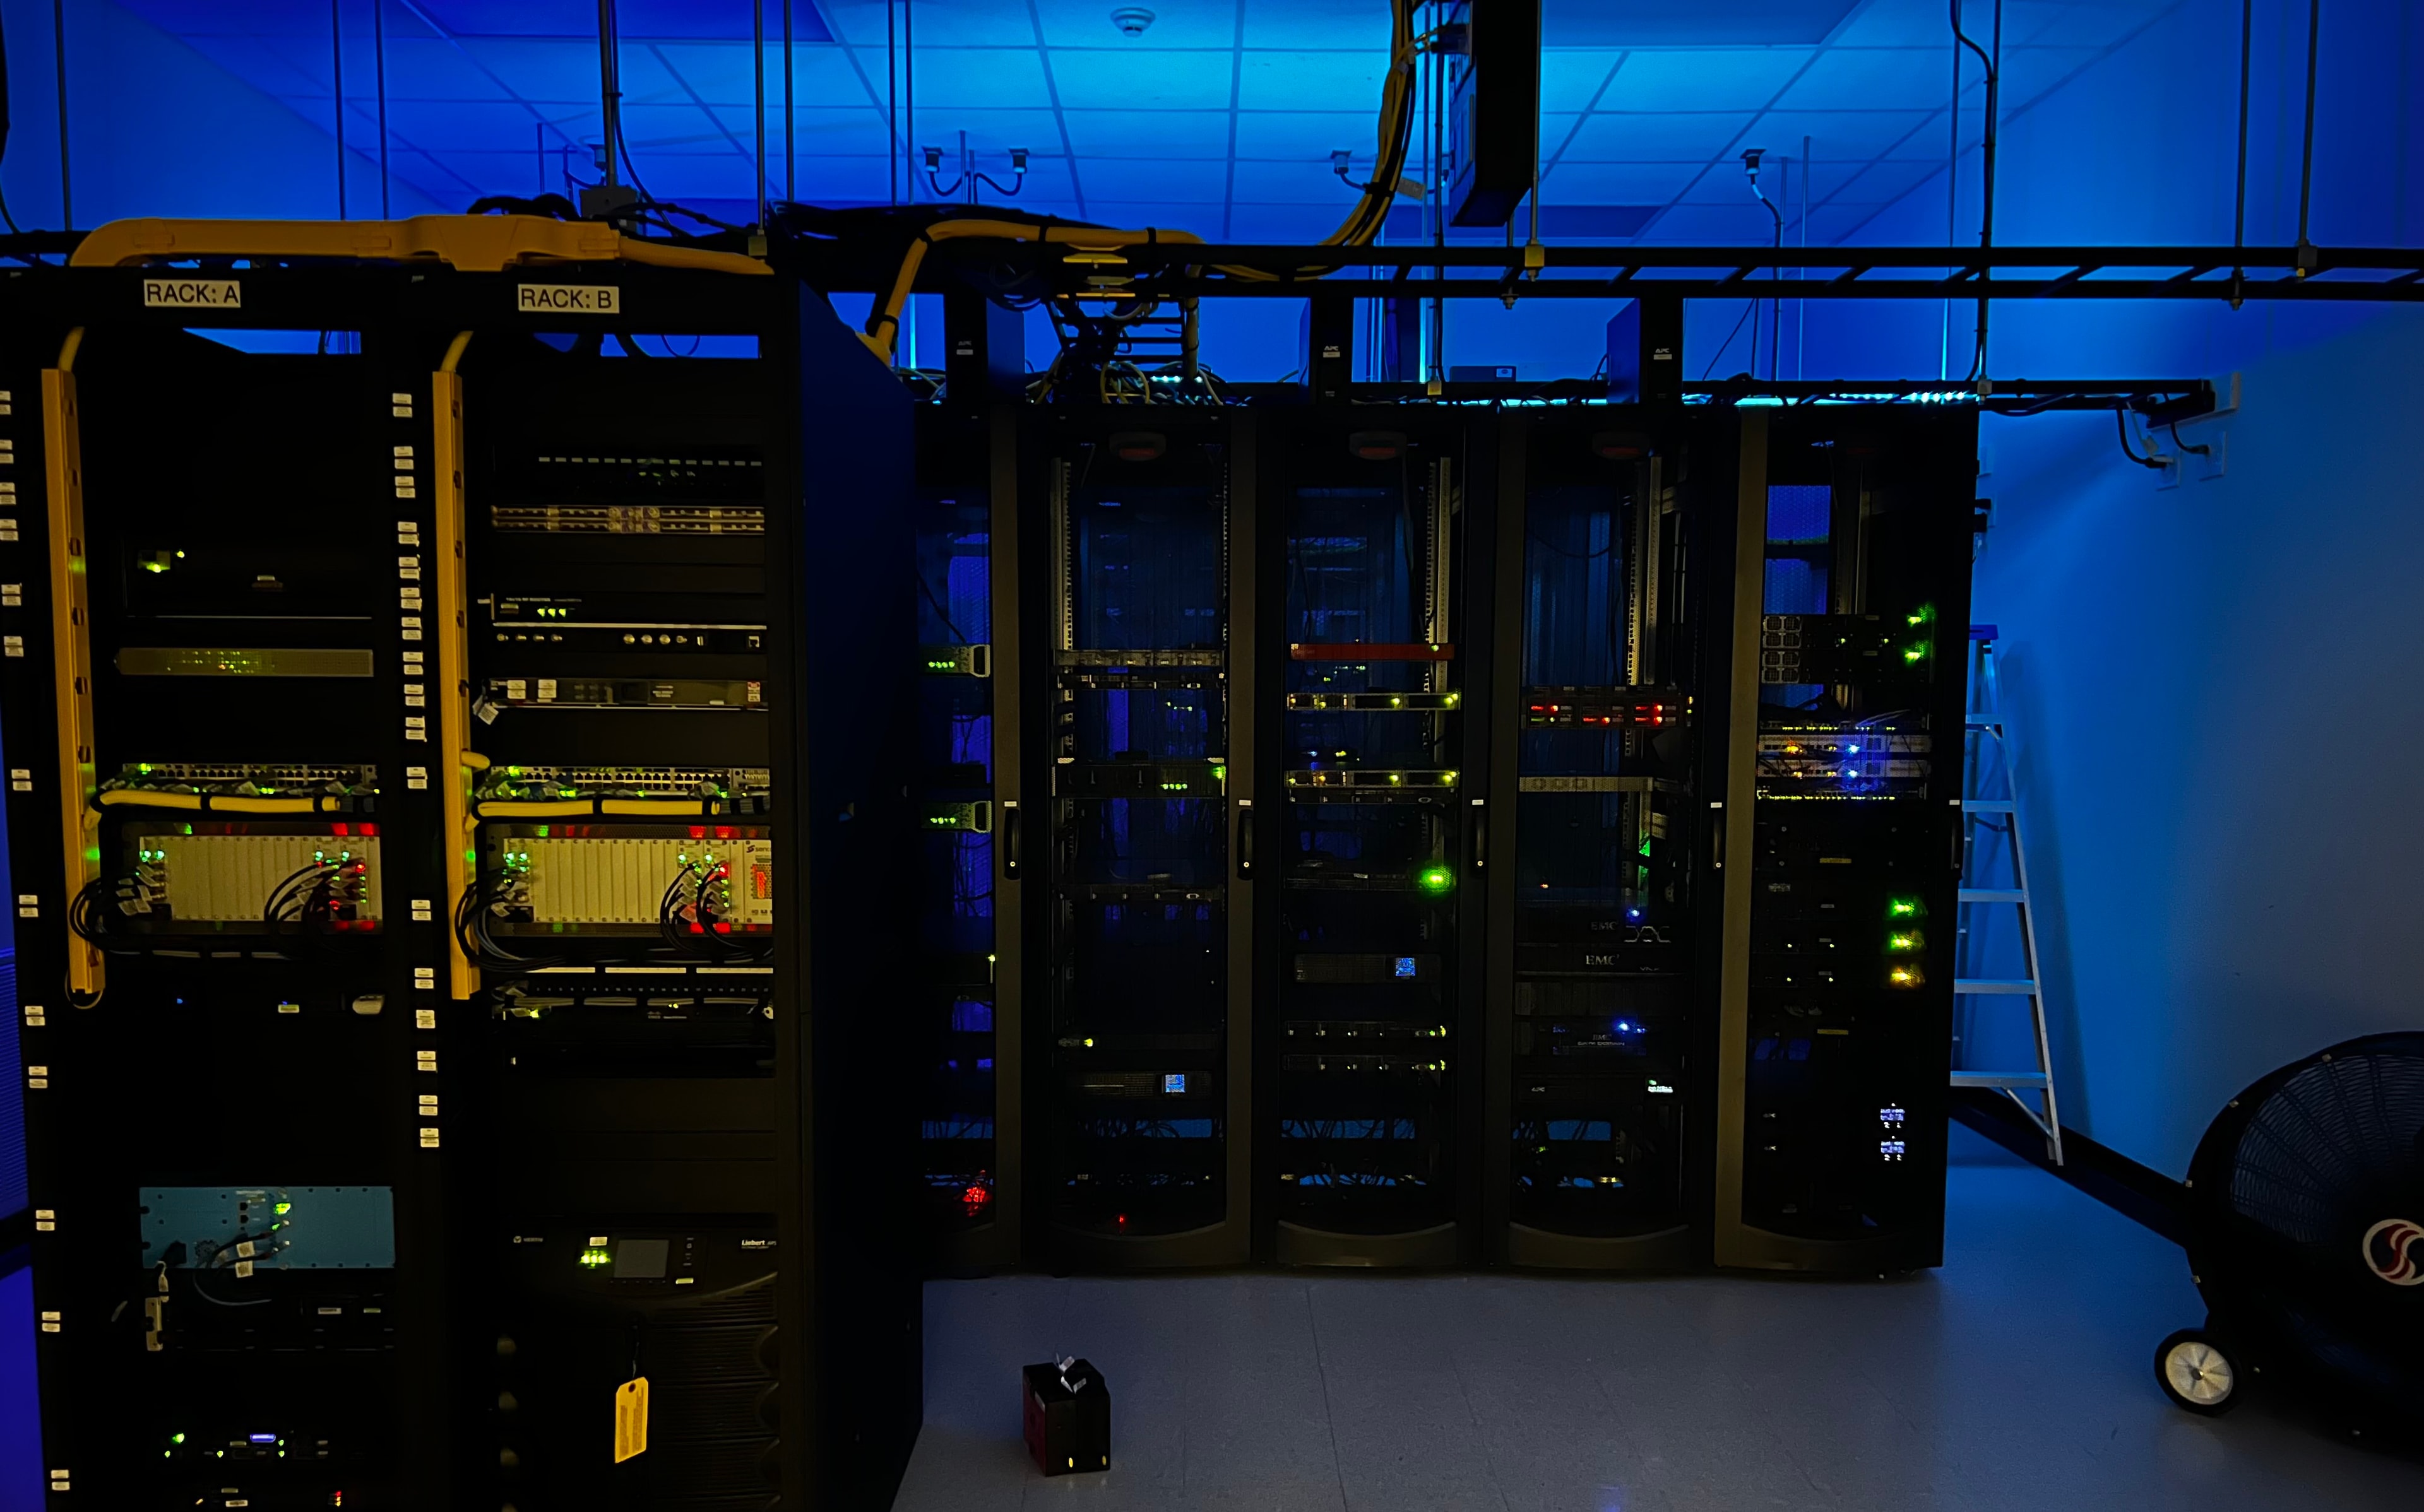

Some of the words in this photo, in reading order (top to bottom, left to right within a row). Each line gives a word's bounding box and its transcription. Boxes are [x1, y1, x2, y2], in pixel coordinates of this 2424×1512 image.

[146, 284, 217, 303] RACK:
[223, 285, 239, 304] A
[521, 288, 591, 309] RACK:
[598, 290, 612, 309] B
